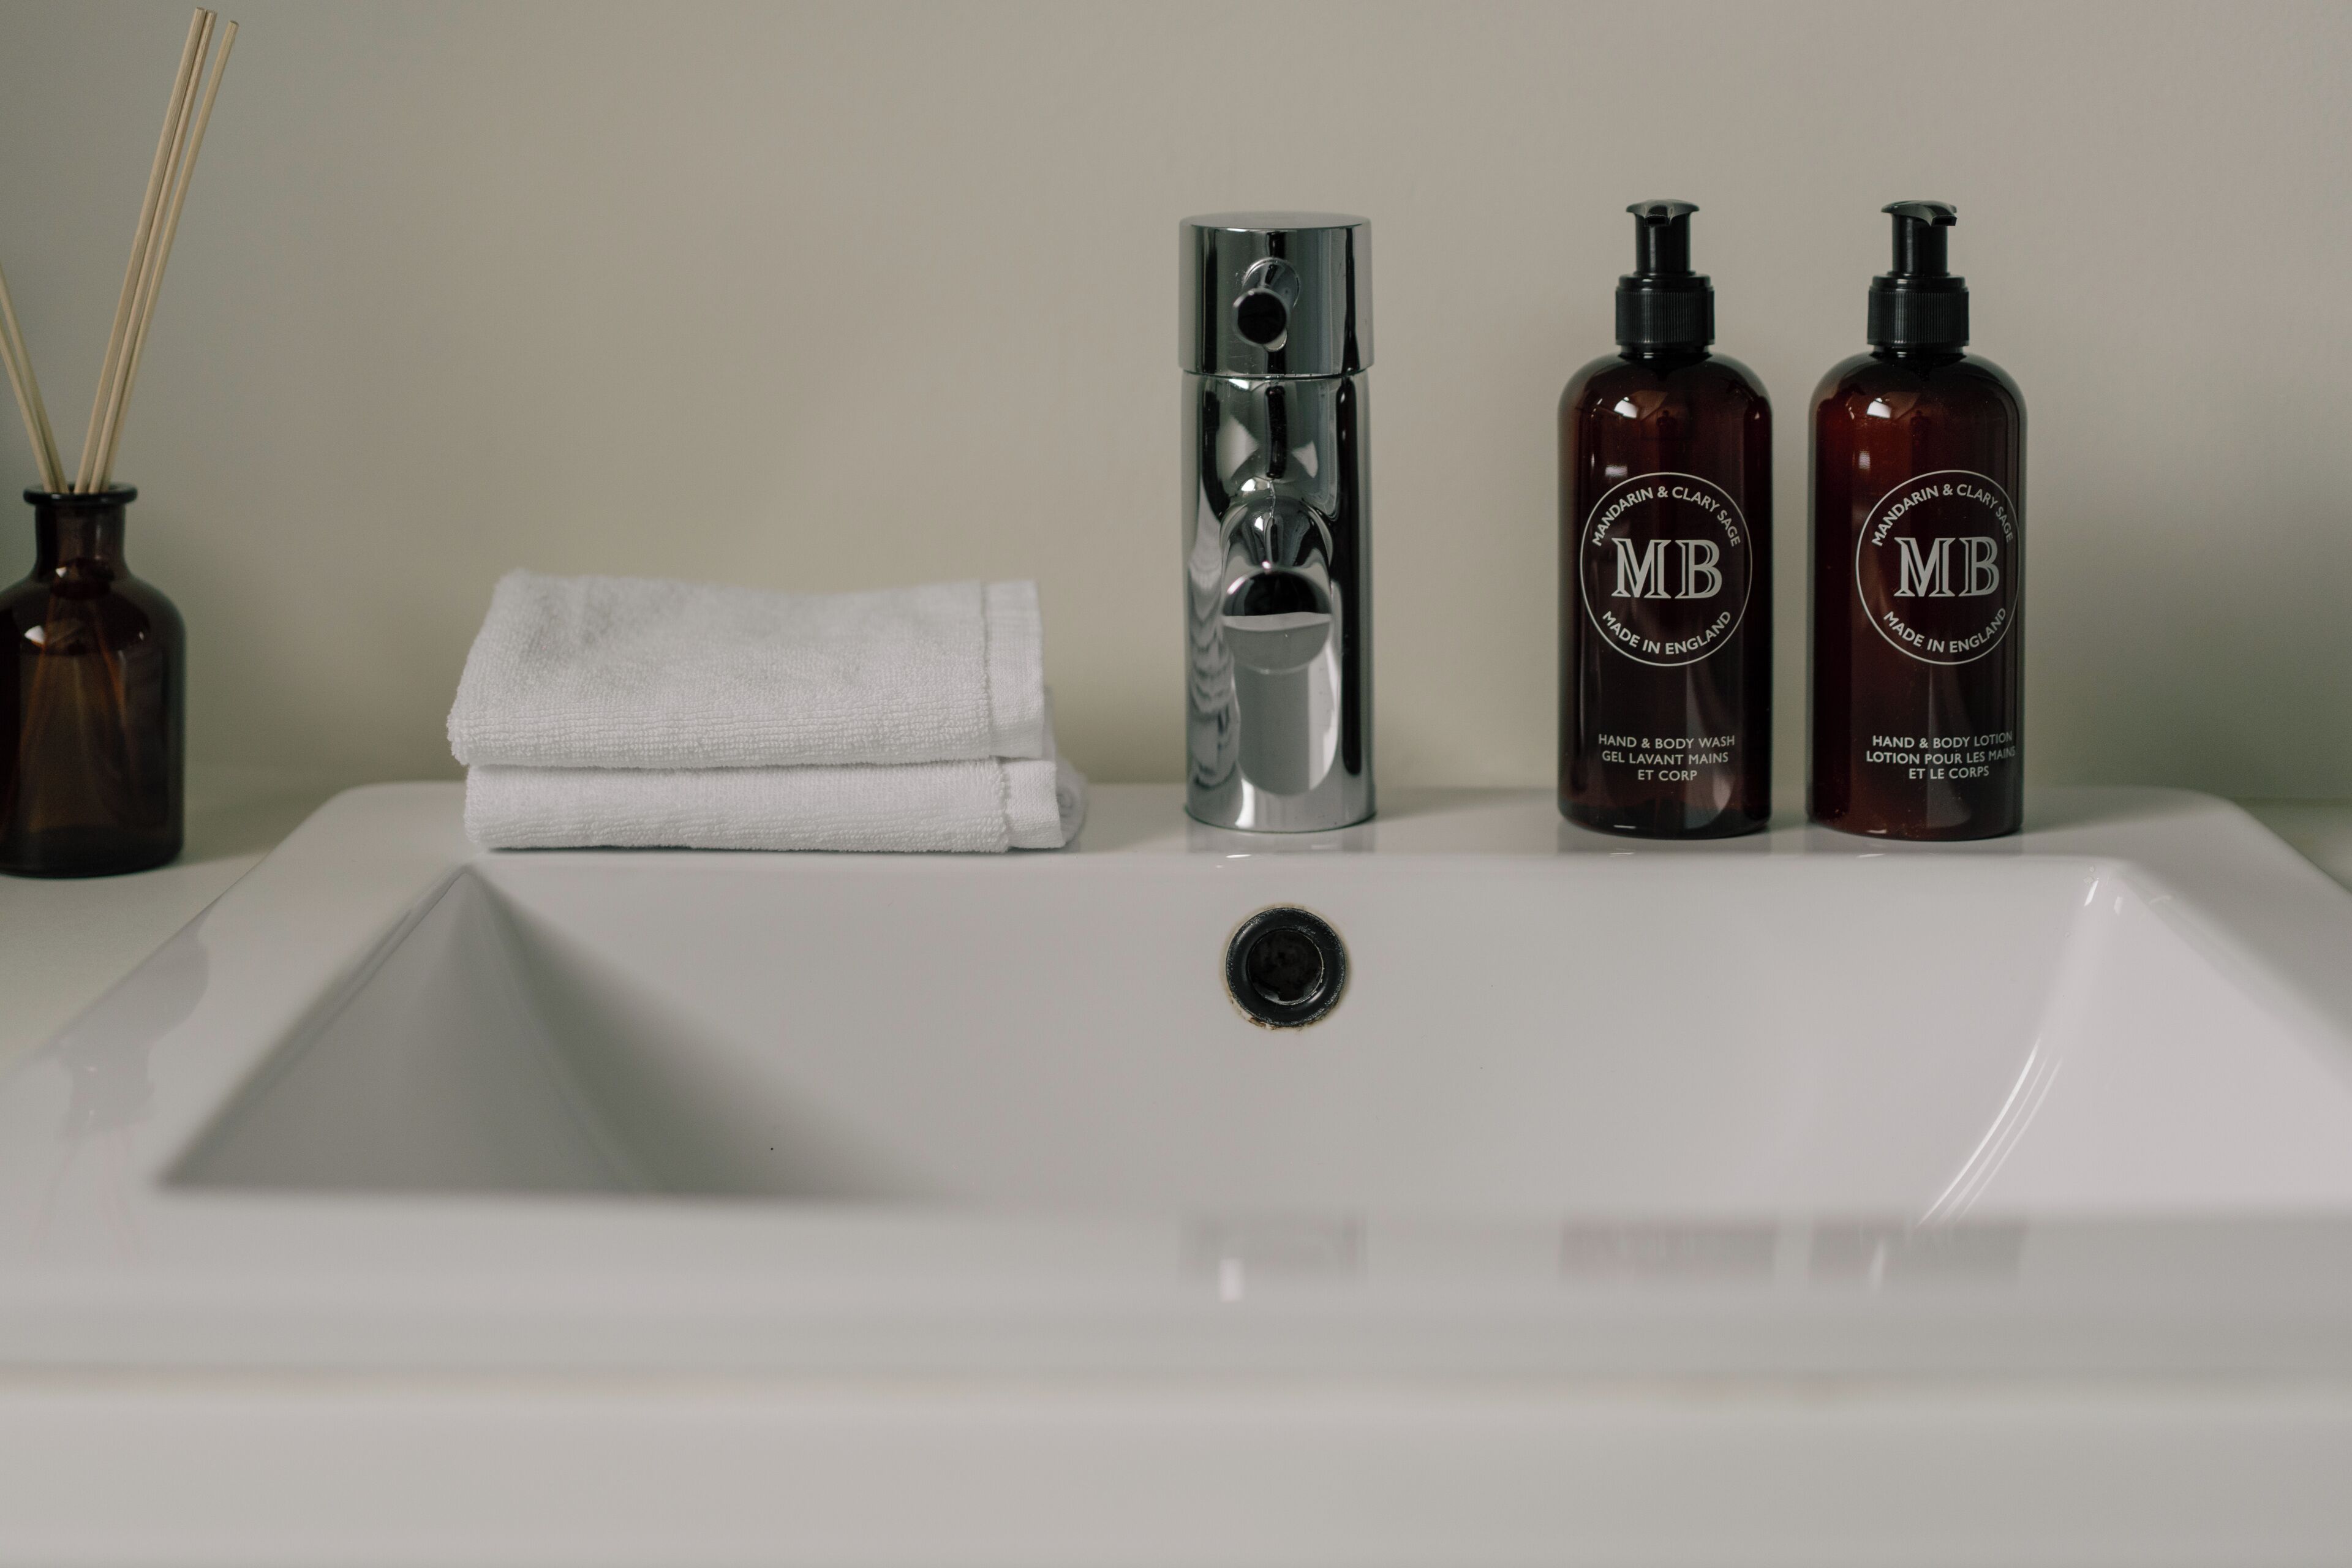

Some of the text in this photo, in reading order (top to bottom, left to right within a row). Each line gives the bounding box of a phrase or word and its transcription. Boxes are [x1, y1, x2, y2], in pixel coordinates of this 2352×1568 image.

[1592, 486, 1741, 547] MANDARIN & CLARY SAGE
[1872, 484, 2013, 546] MANDARIN & CLARY SAGE
[1611, 537, 1722, 599] MB
[1894, 537, 2000, 597] MB
[1602, 611, 1731, 654] MADE IN ENGLAND
[1883, 608, 2006, 653] MADE IN ENGLAND
[1599, 734, 1735, 749] HAND & BODY WASH
[1872, 731, 2013, 748] HAND & BODY LOTION
[1602, 750, 1728, 765] GEL LAVANT MAINS
[1866, 746, 2015, 764] LOTION POUR LES MAINS
[1638, 769, 1697, 781] ET CORP
[1909, 766, 1989, 779] ET LE CORPS
